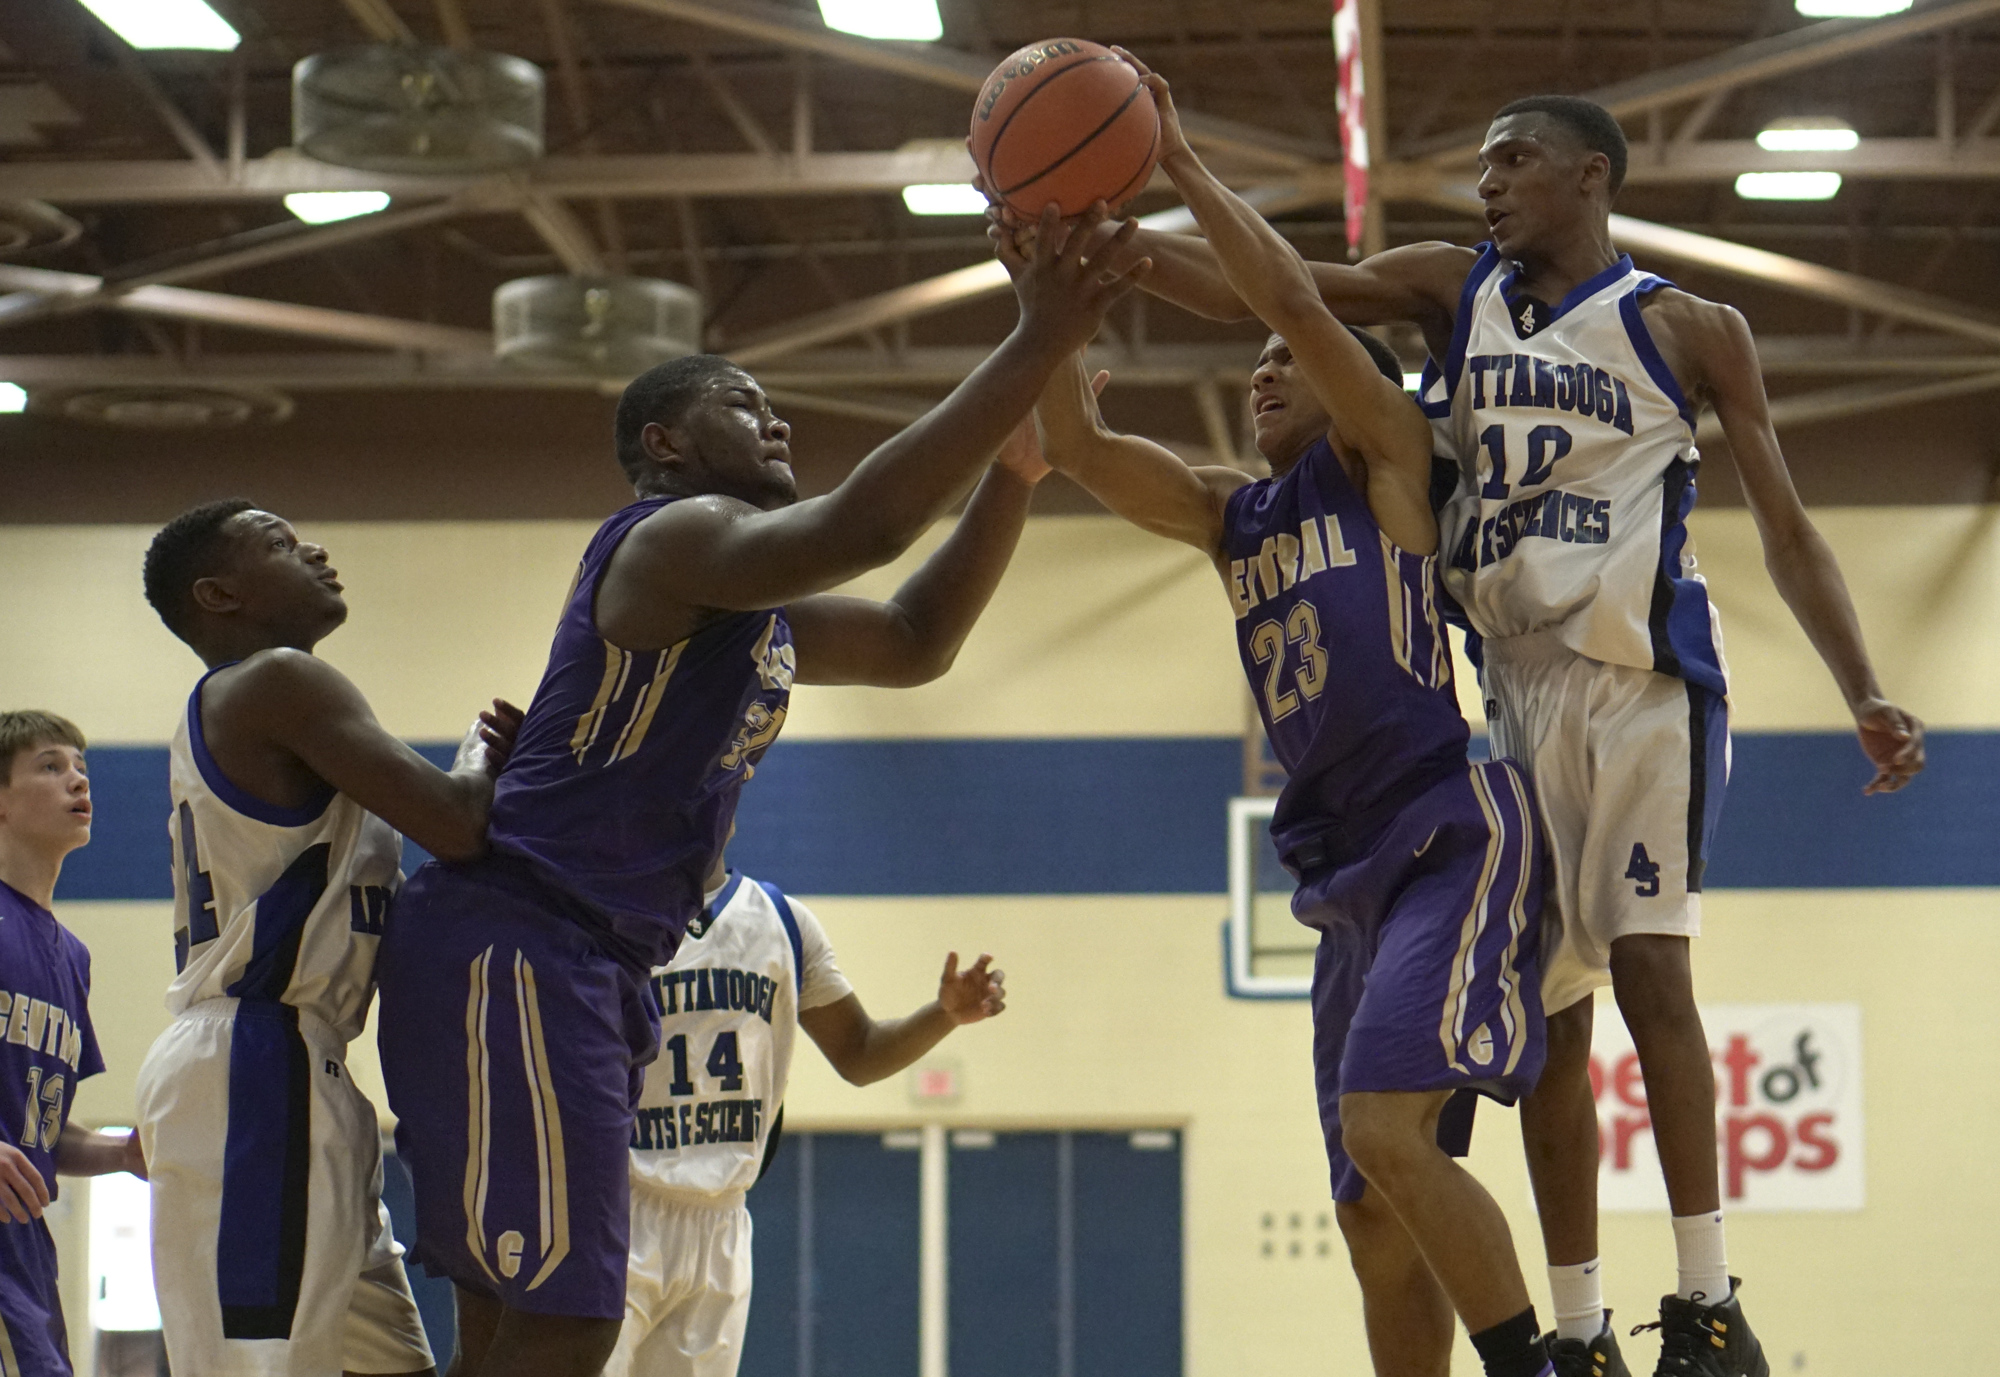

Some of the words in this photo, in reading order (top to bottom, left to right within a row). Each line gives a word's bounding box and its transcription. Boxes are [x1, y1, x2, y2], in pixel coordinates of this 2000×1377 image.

[979, 41, 1084, 122] Wilson
[1250, 599, 1329, 724] 23
[666, 1031, 743, 1097] 14
[1762, 1026, 1821, 1103] of
[20, 1066, 65, 1153] 13
